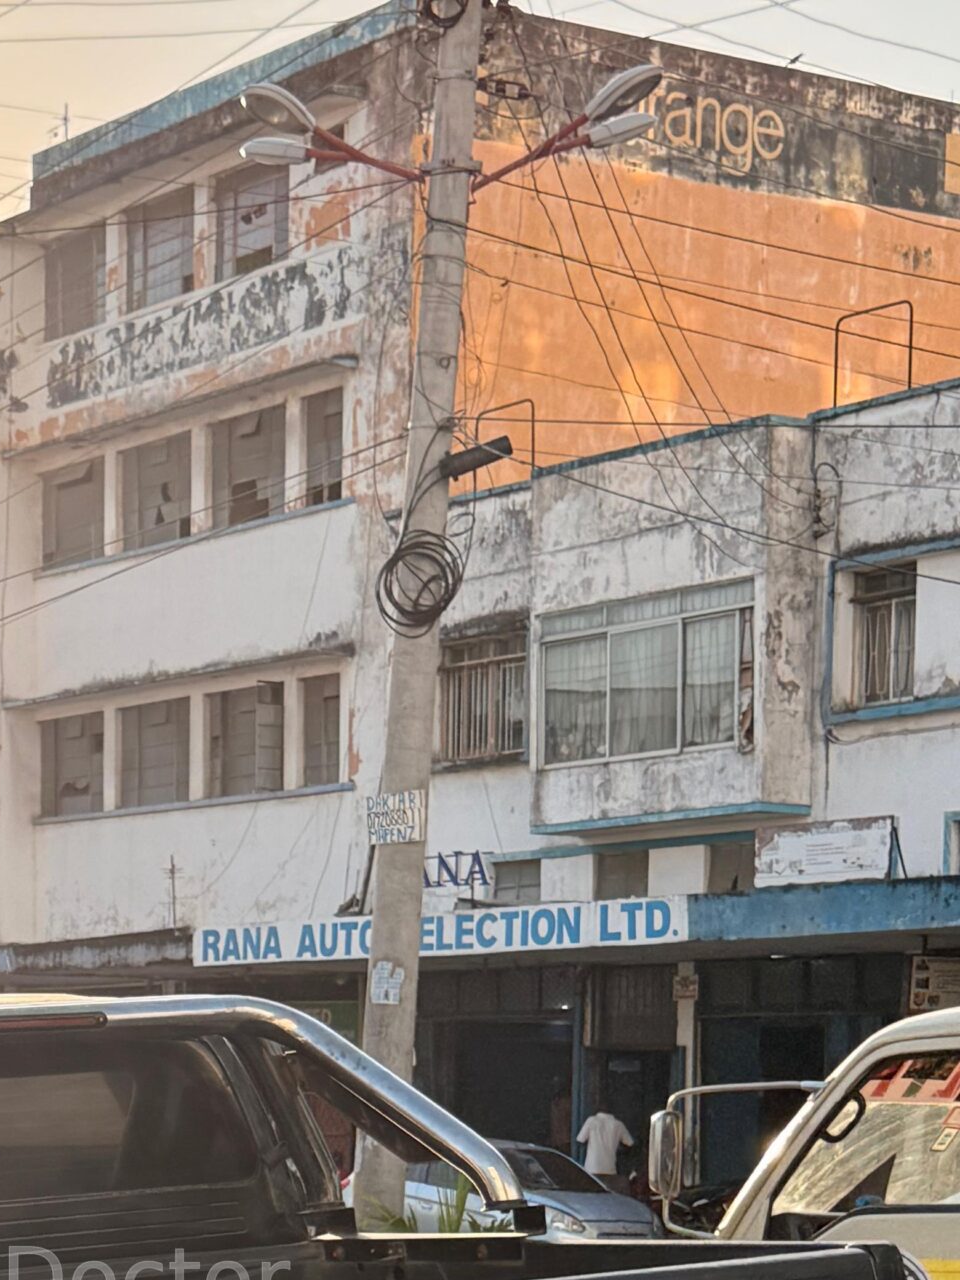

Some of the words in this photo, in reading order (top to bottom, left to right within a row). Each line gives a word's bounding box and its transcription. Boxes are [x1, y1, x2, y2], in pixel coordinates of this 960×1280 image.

[639, 91, 785, 176] range
[202, 926, 282, 962] RANA
[420, 906, 581, 951] ELECTION
[599, 900, 679, 942] LTD.
